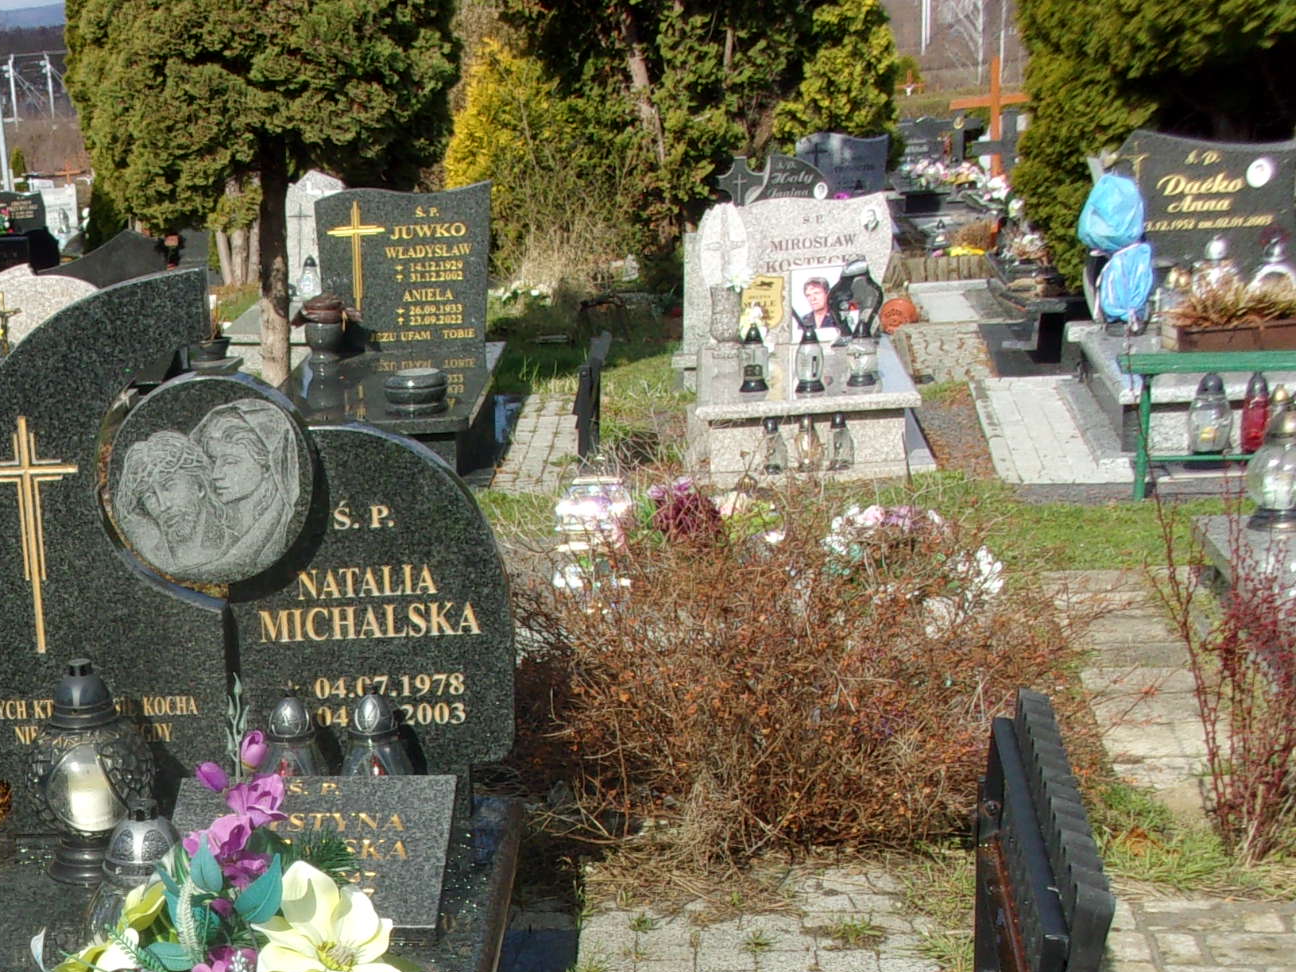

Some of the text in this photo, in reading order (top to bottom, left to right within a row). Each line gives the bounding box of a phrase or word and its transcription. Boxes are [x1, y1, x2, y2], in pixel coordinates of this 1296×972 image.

[429, 206, 439, 217] P.
[1168, 196, 1233, 213] Anna
[391, 222, 467, 240] JUWKO
[403, 288, 454, 302] ANIELA
[401, 330, 432, 341] UFAM
[442, 328, 476, 340] TOBIE
[333, 501, 395, 530] Ś. P.
[297, 562, 439, 601] NATALIA
[259, 600, 482, 643] MICHALSKA
[313, 672, 466, 700] 04.07.1978
[143, 695, 199, 716] KOCHA
[320, 783, 341, 795] P.
